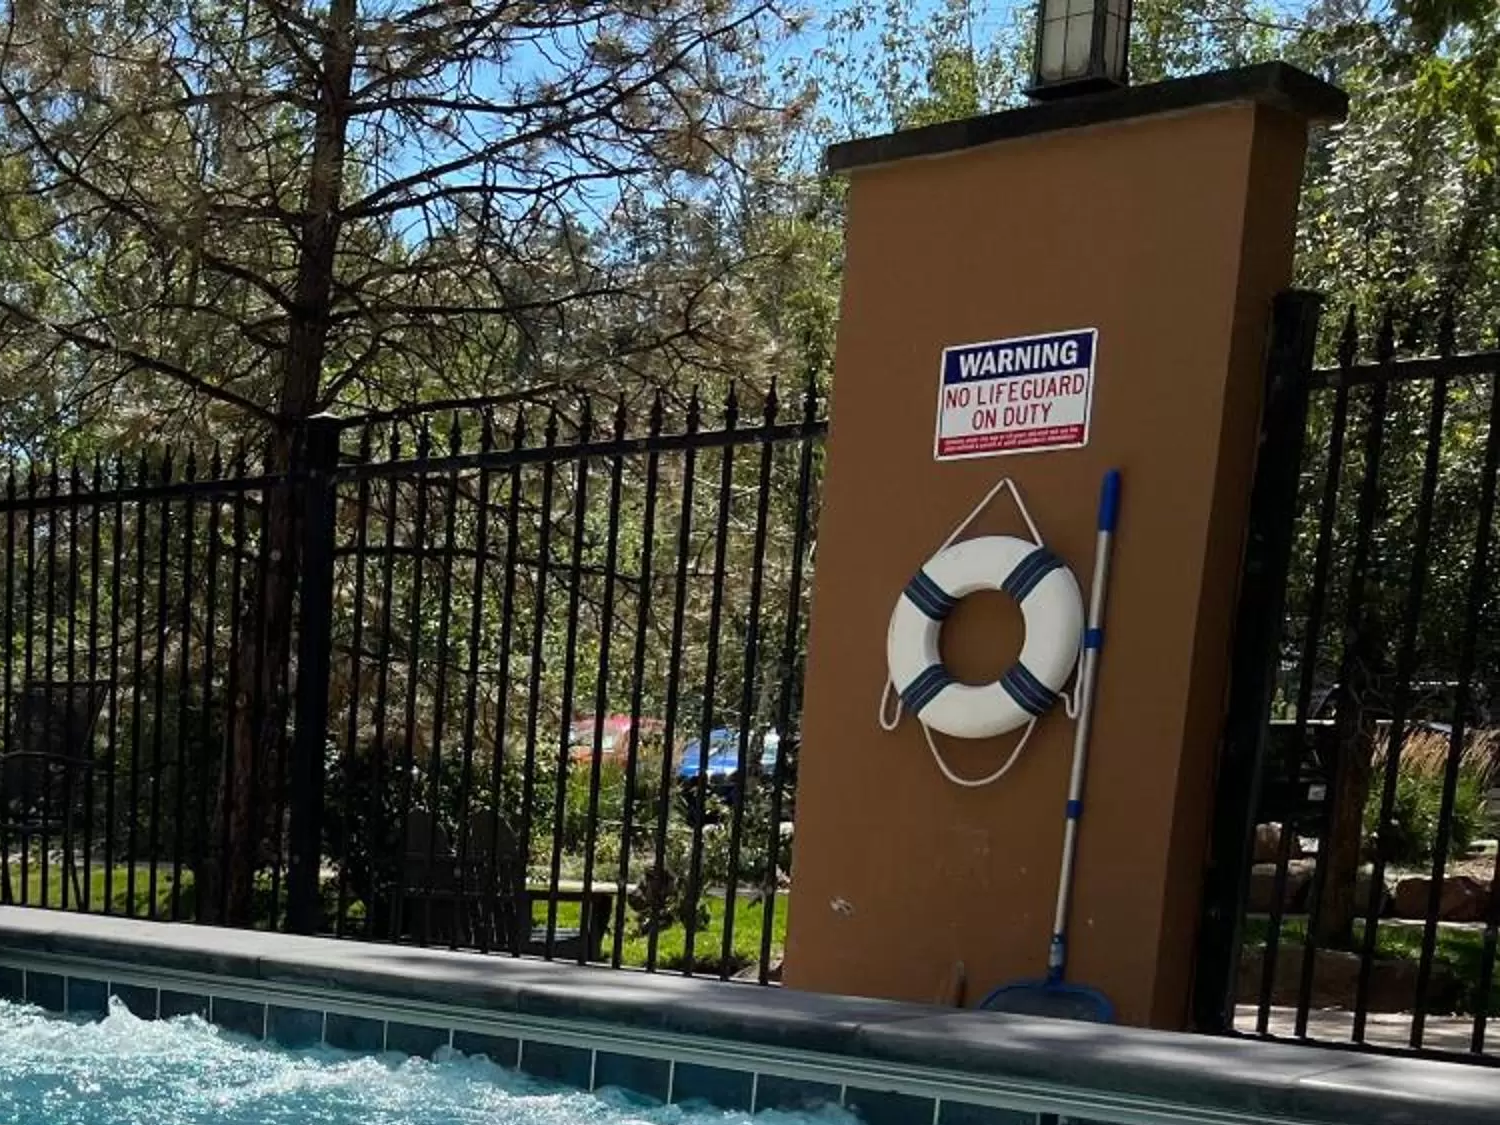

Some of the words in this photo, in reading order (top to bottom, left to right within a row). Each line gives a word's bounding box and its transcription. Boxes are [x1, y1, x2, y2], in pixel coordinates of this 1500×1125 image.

[959, 340, 1078, 378] WARNING
[946, 387, 970, 409] NO
[977, 373, 1084, 405] LIFEGUARD
[972, 409, 997, 430] ON
[1003, 402, 1052, 427] DUTY
